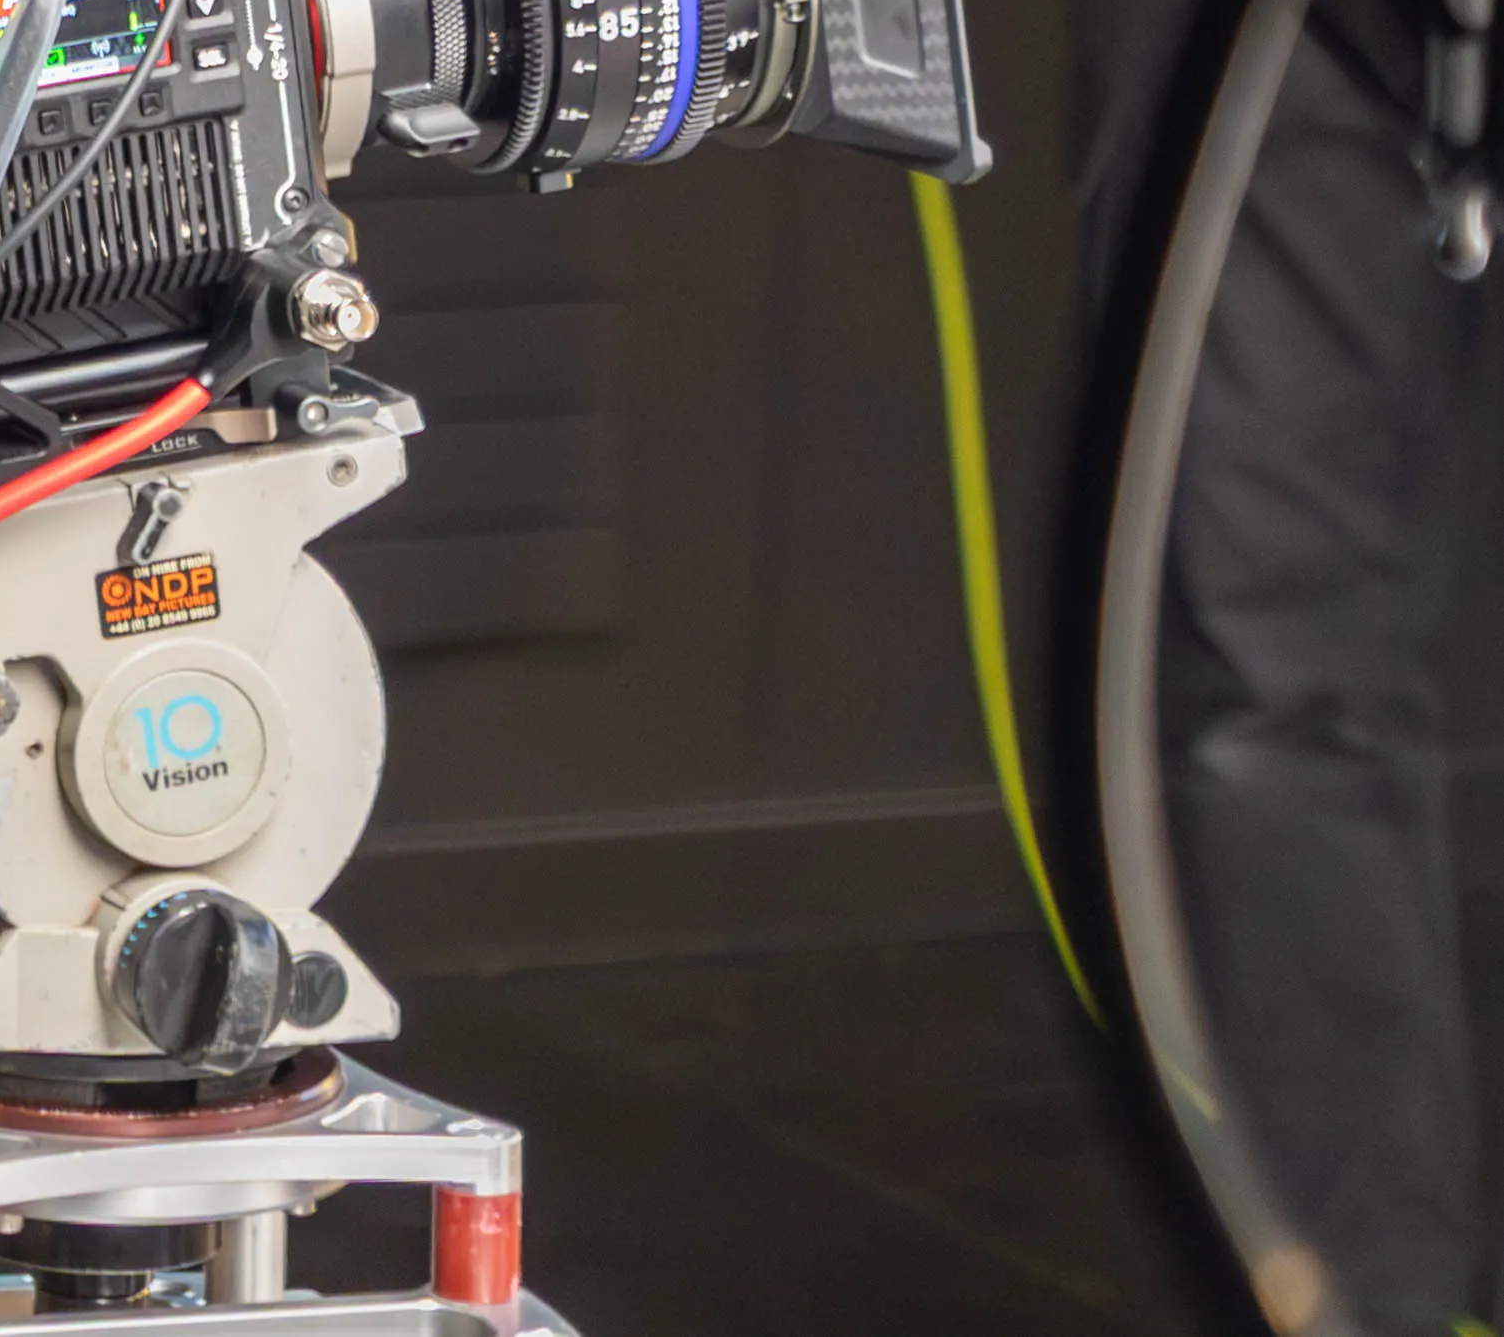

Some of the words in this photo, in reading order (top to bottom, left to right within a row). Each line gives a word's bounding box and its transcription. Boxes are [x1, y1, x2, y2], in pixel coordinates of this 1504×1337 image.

[598, 6, 640, 41] 85
[152, 434, 199, 454] LOCK
[180, 555, 212, 570] FROM
[105, 607, 132, 623] NEW
[134, 603, 156, 618] DAY
[159, 591, 216, 613] PICTURES
[133, 694, 222, 769] 10
[142, 760, 229, 792] Vision
